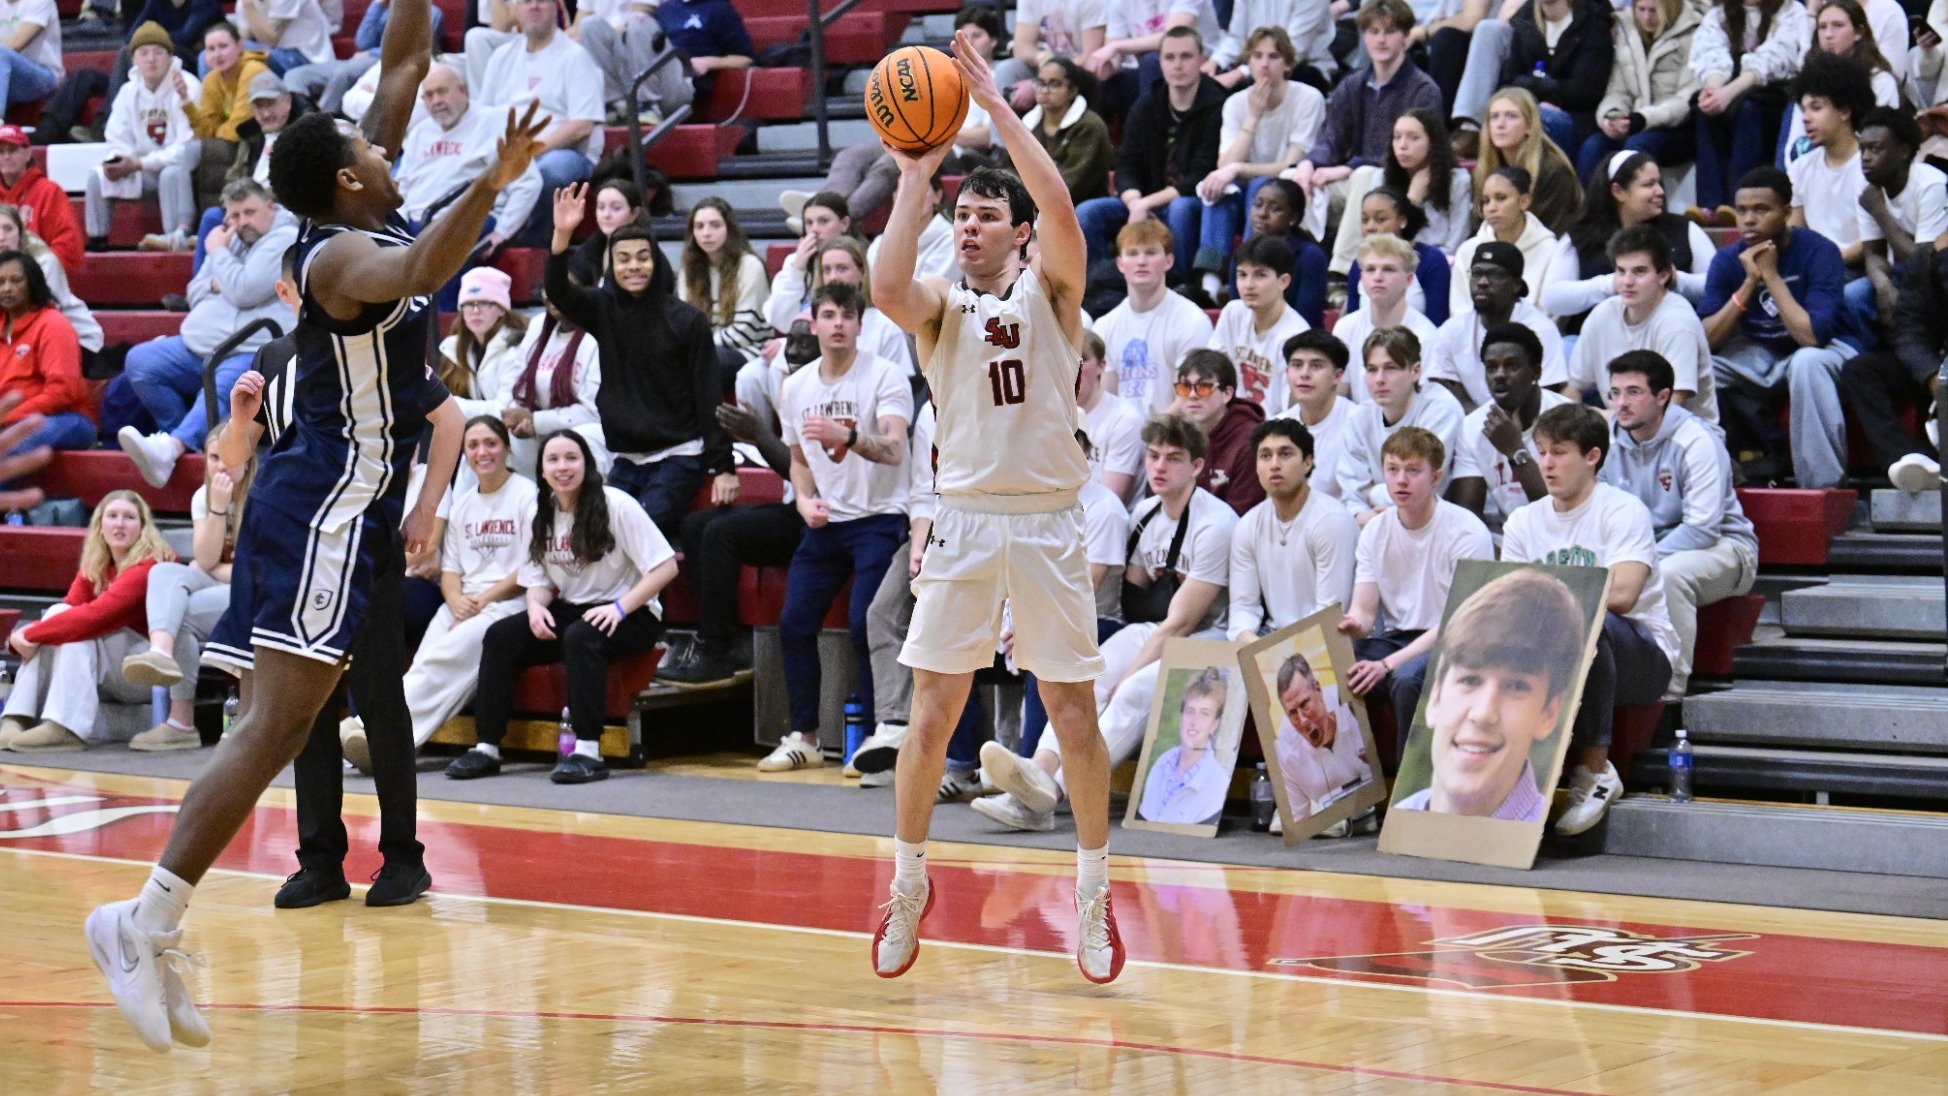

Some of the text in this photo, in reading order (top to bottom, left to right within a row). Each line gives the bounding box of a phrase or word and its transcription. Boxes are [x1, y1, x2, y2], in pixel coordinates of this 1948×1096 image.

[896, 58, 918, 102] NCAA
[989, 359, 1025, 406] 10
[475, 518, 516, 537] LAWRENCE
